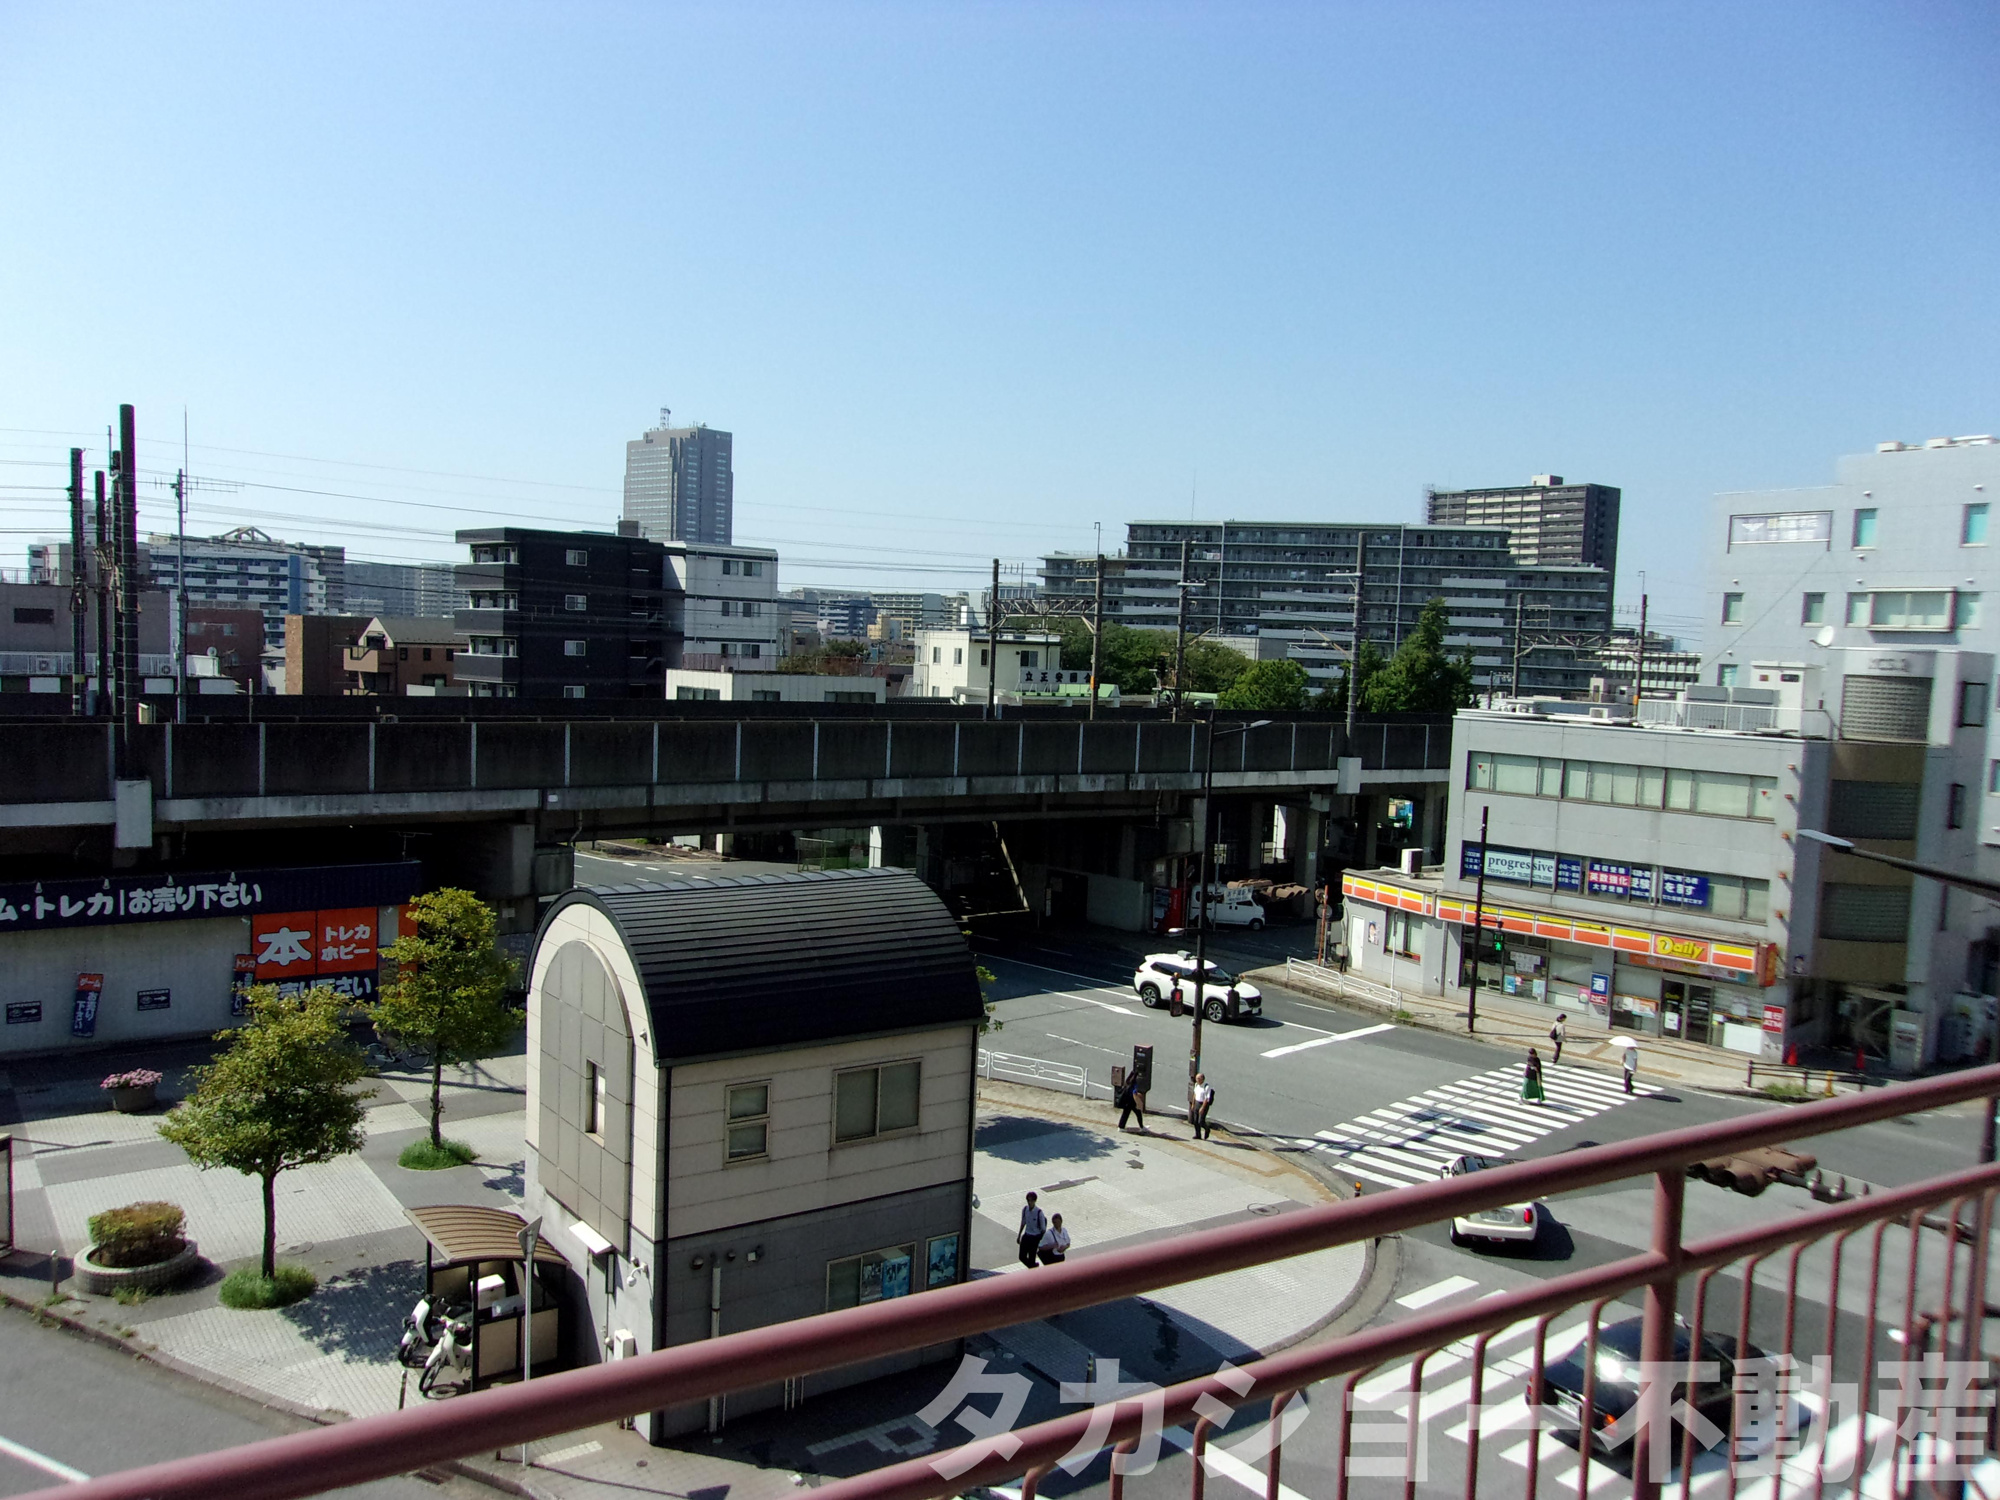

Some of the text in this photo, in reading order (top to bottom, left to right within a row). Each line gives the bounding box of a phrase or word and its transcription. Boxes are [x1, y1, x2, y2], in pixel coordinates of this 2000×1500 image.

[1487, 856, 1553, 873] progressive
[128, 882, 262, 914] お売り下さい
[325, 924, 371, 942] トレカ
[257, 927, 312, 966] 本
[321, 943, 370, 961] ホビー
[1656, 935, 1704, 959] Daily
[236, 958, 256, 968] トレカ
